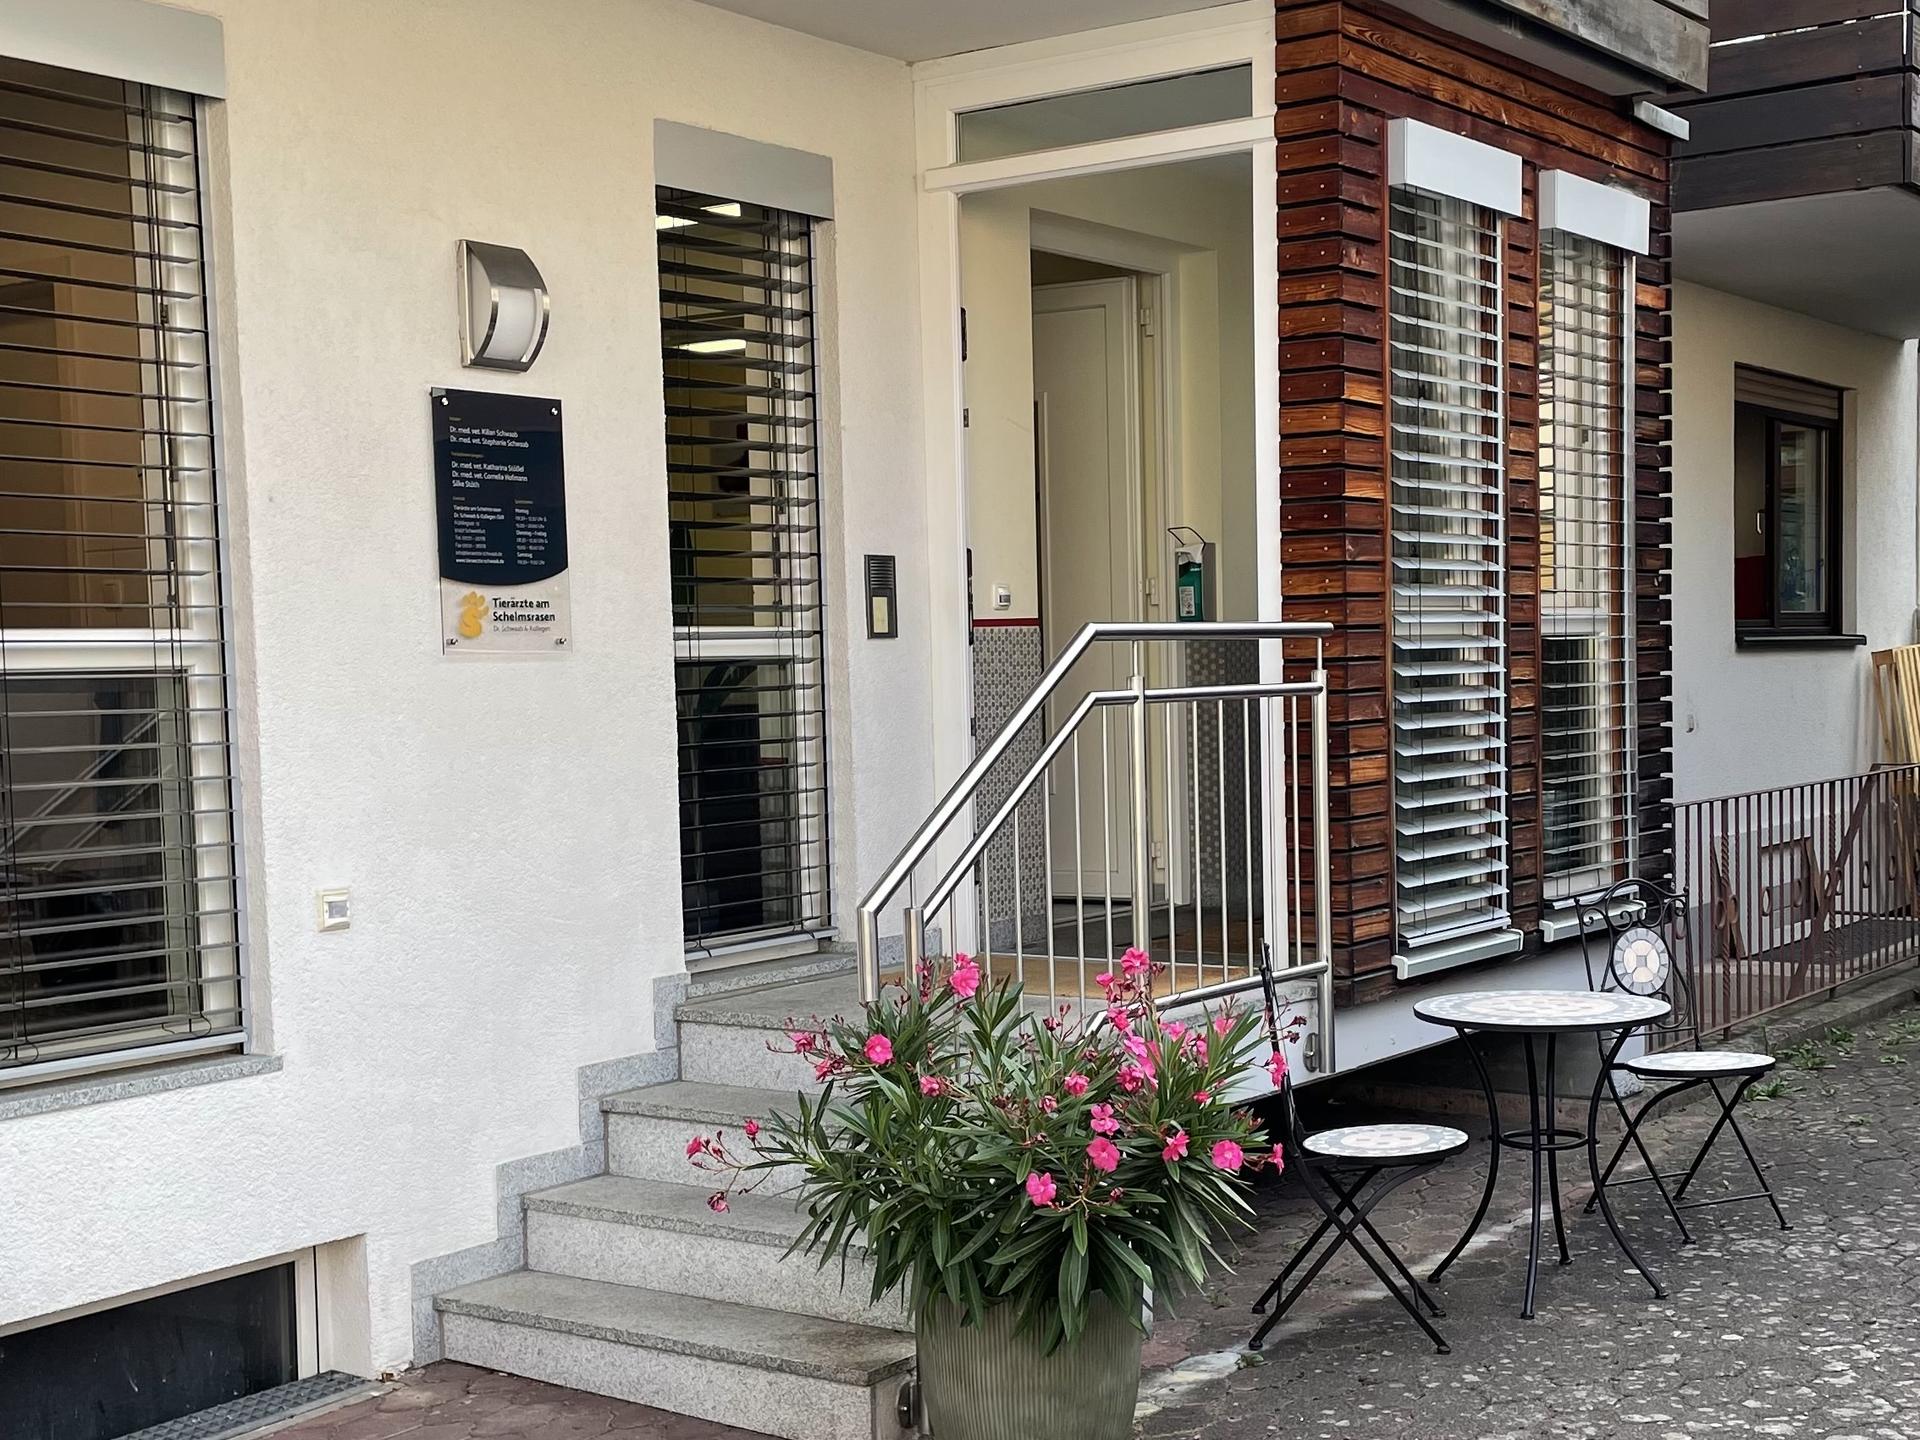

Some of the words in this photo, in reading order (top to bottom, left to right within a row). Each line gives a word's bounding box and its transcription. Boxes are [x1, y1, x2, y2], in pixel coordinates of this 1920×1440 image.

[492, 597, 534, 608] Tierärzte
[536, 600, 550, 608] am
[492, 612, 555, 622] Schelmsrasen
